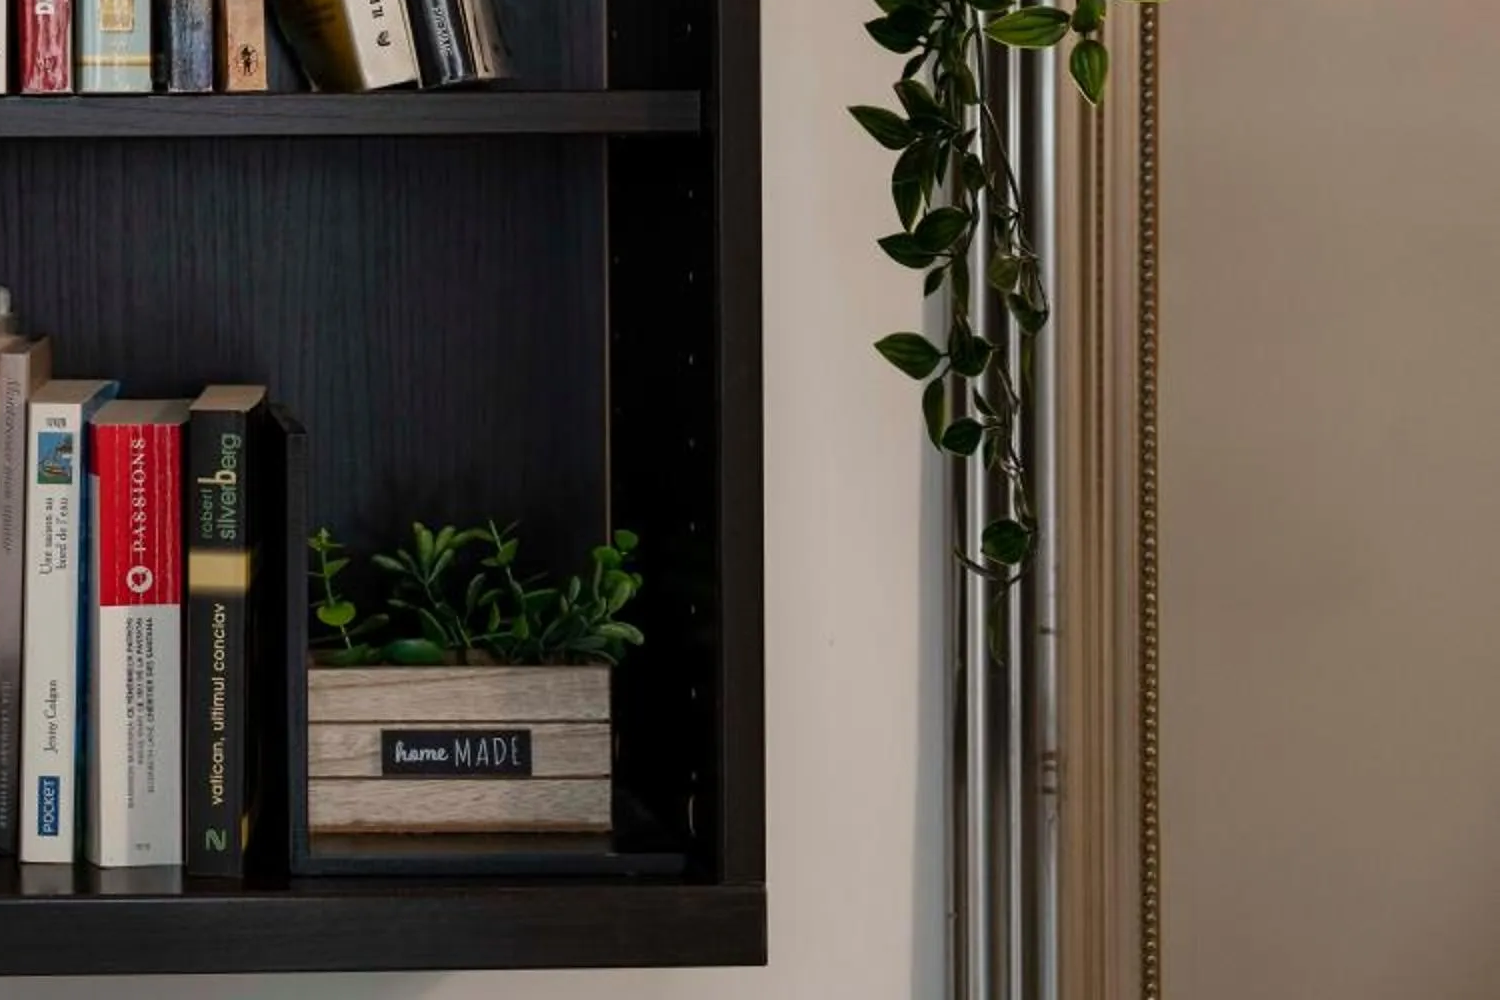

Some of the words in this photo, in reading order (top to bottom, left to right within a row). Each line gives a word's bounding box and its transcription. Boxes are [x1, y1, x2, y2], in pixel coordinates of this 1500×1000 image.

[371, 5, 386, 19] IL
[131, 437, 147, 553] PASSIONS
[196, 432, 243, 541] silverberg
[198, 488, 214, 540] robert
[209, 603, 226, 672] conclav
[208, 676, 226, 731] ultimul
[208, 737, 226, 805] vatican,
[394, 739, 450, 764] home
[453, 736, 522, 768] MADE
